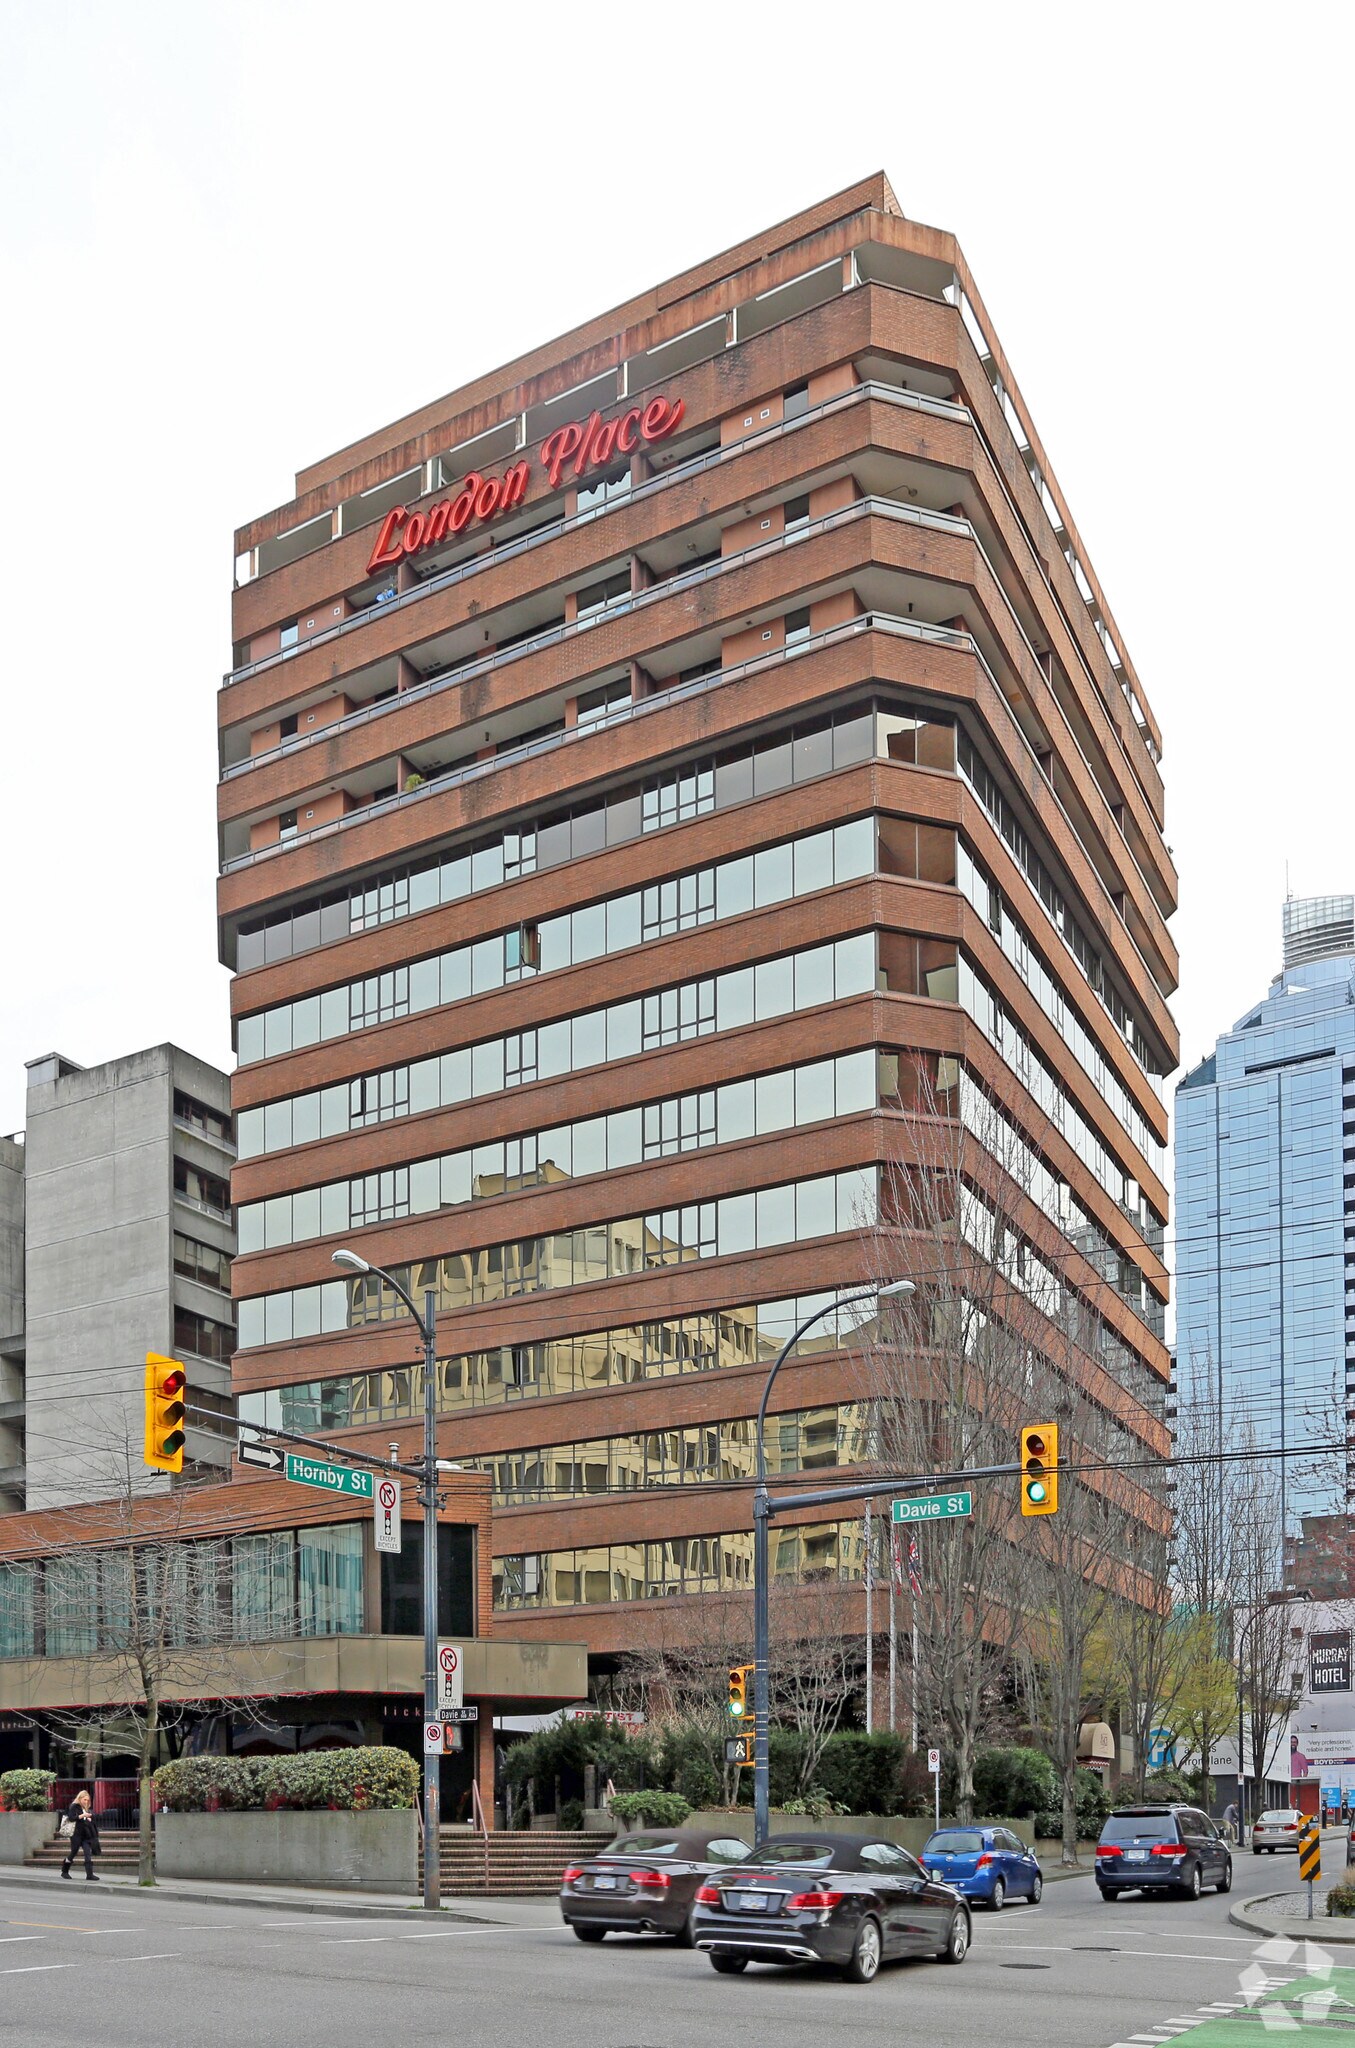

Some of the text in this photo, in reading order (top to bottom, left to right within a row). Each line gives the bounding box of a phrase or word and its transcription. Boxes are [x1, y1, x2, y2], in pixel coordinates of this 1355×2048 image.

[365, 395, 686, 576] London Place
[293, 1458, 367, 1491] Hornby St
[900, 1498, 964, 1518] Davie St
[379, 1535, 396, 1543] EXCEPT
[1312, 1647, 1349, 1664] MURRAY
[1315, 1667, 1347, 1684] HOTEL
[441, 1710, 458, 1719] Davie
[575, 1711, 634, 1721] DETST
[1211, 1756, 1232, 1765] lane
